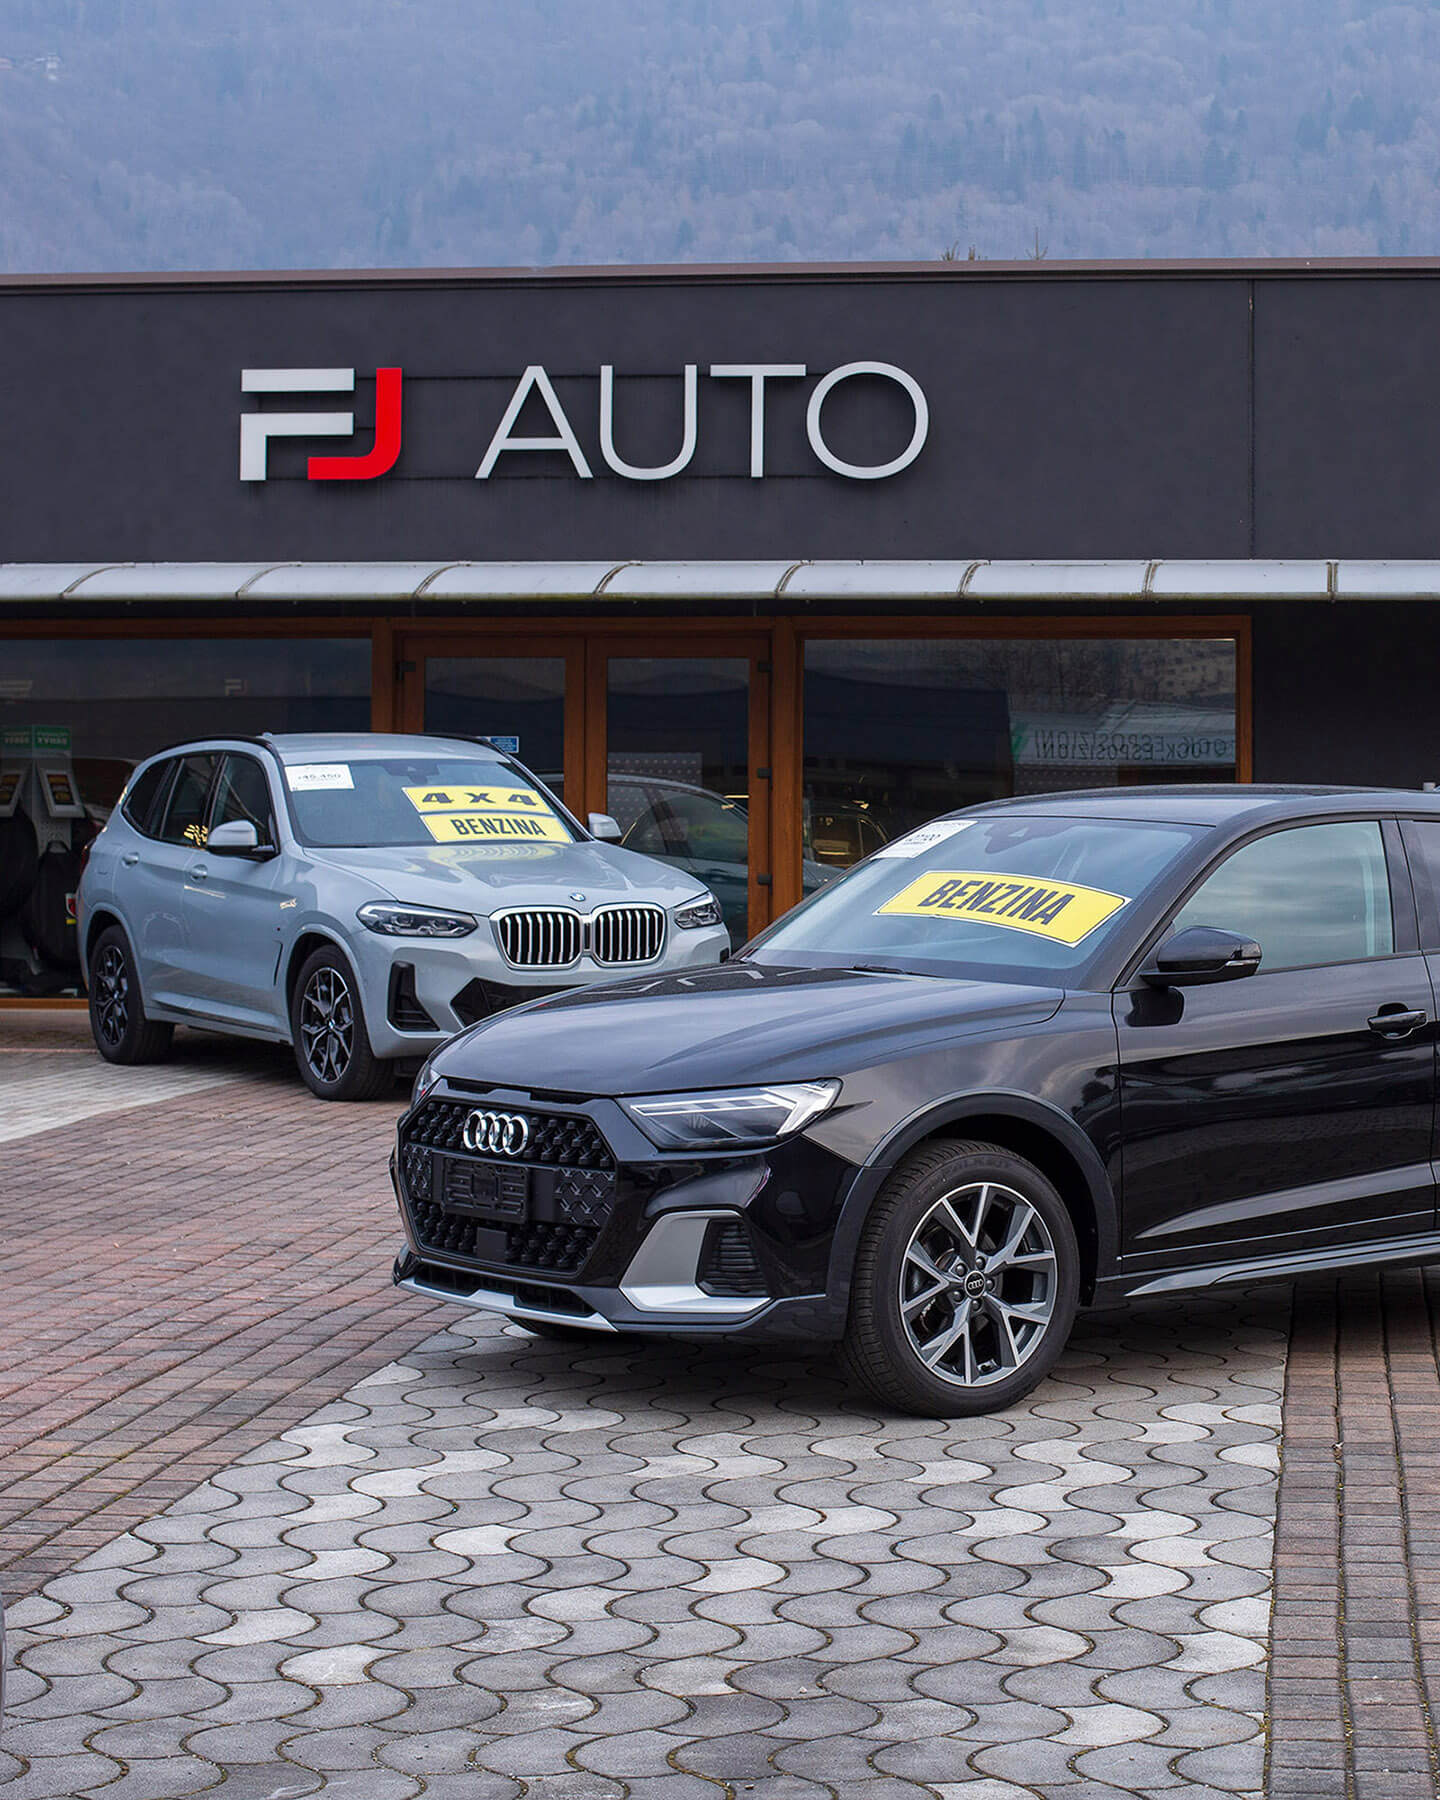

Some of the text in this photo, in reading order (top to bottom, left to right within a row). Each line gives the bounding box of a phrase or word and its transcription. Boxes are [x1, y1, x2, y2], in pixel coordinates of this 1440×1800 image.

[239, 361, 929, 481] FJ AUTO
[450, 819, 547, 836] BENZINA
[917, 879, 1075, 925] BENZINA
